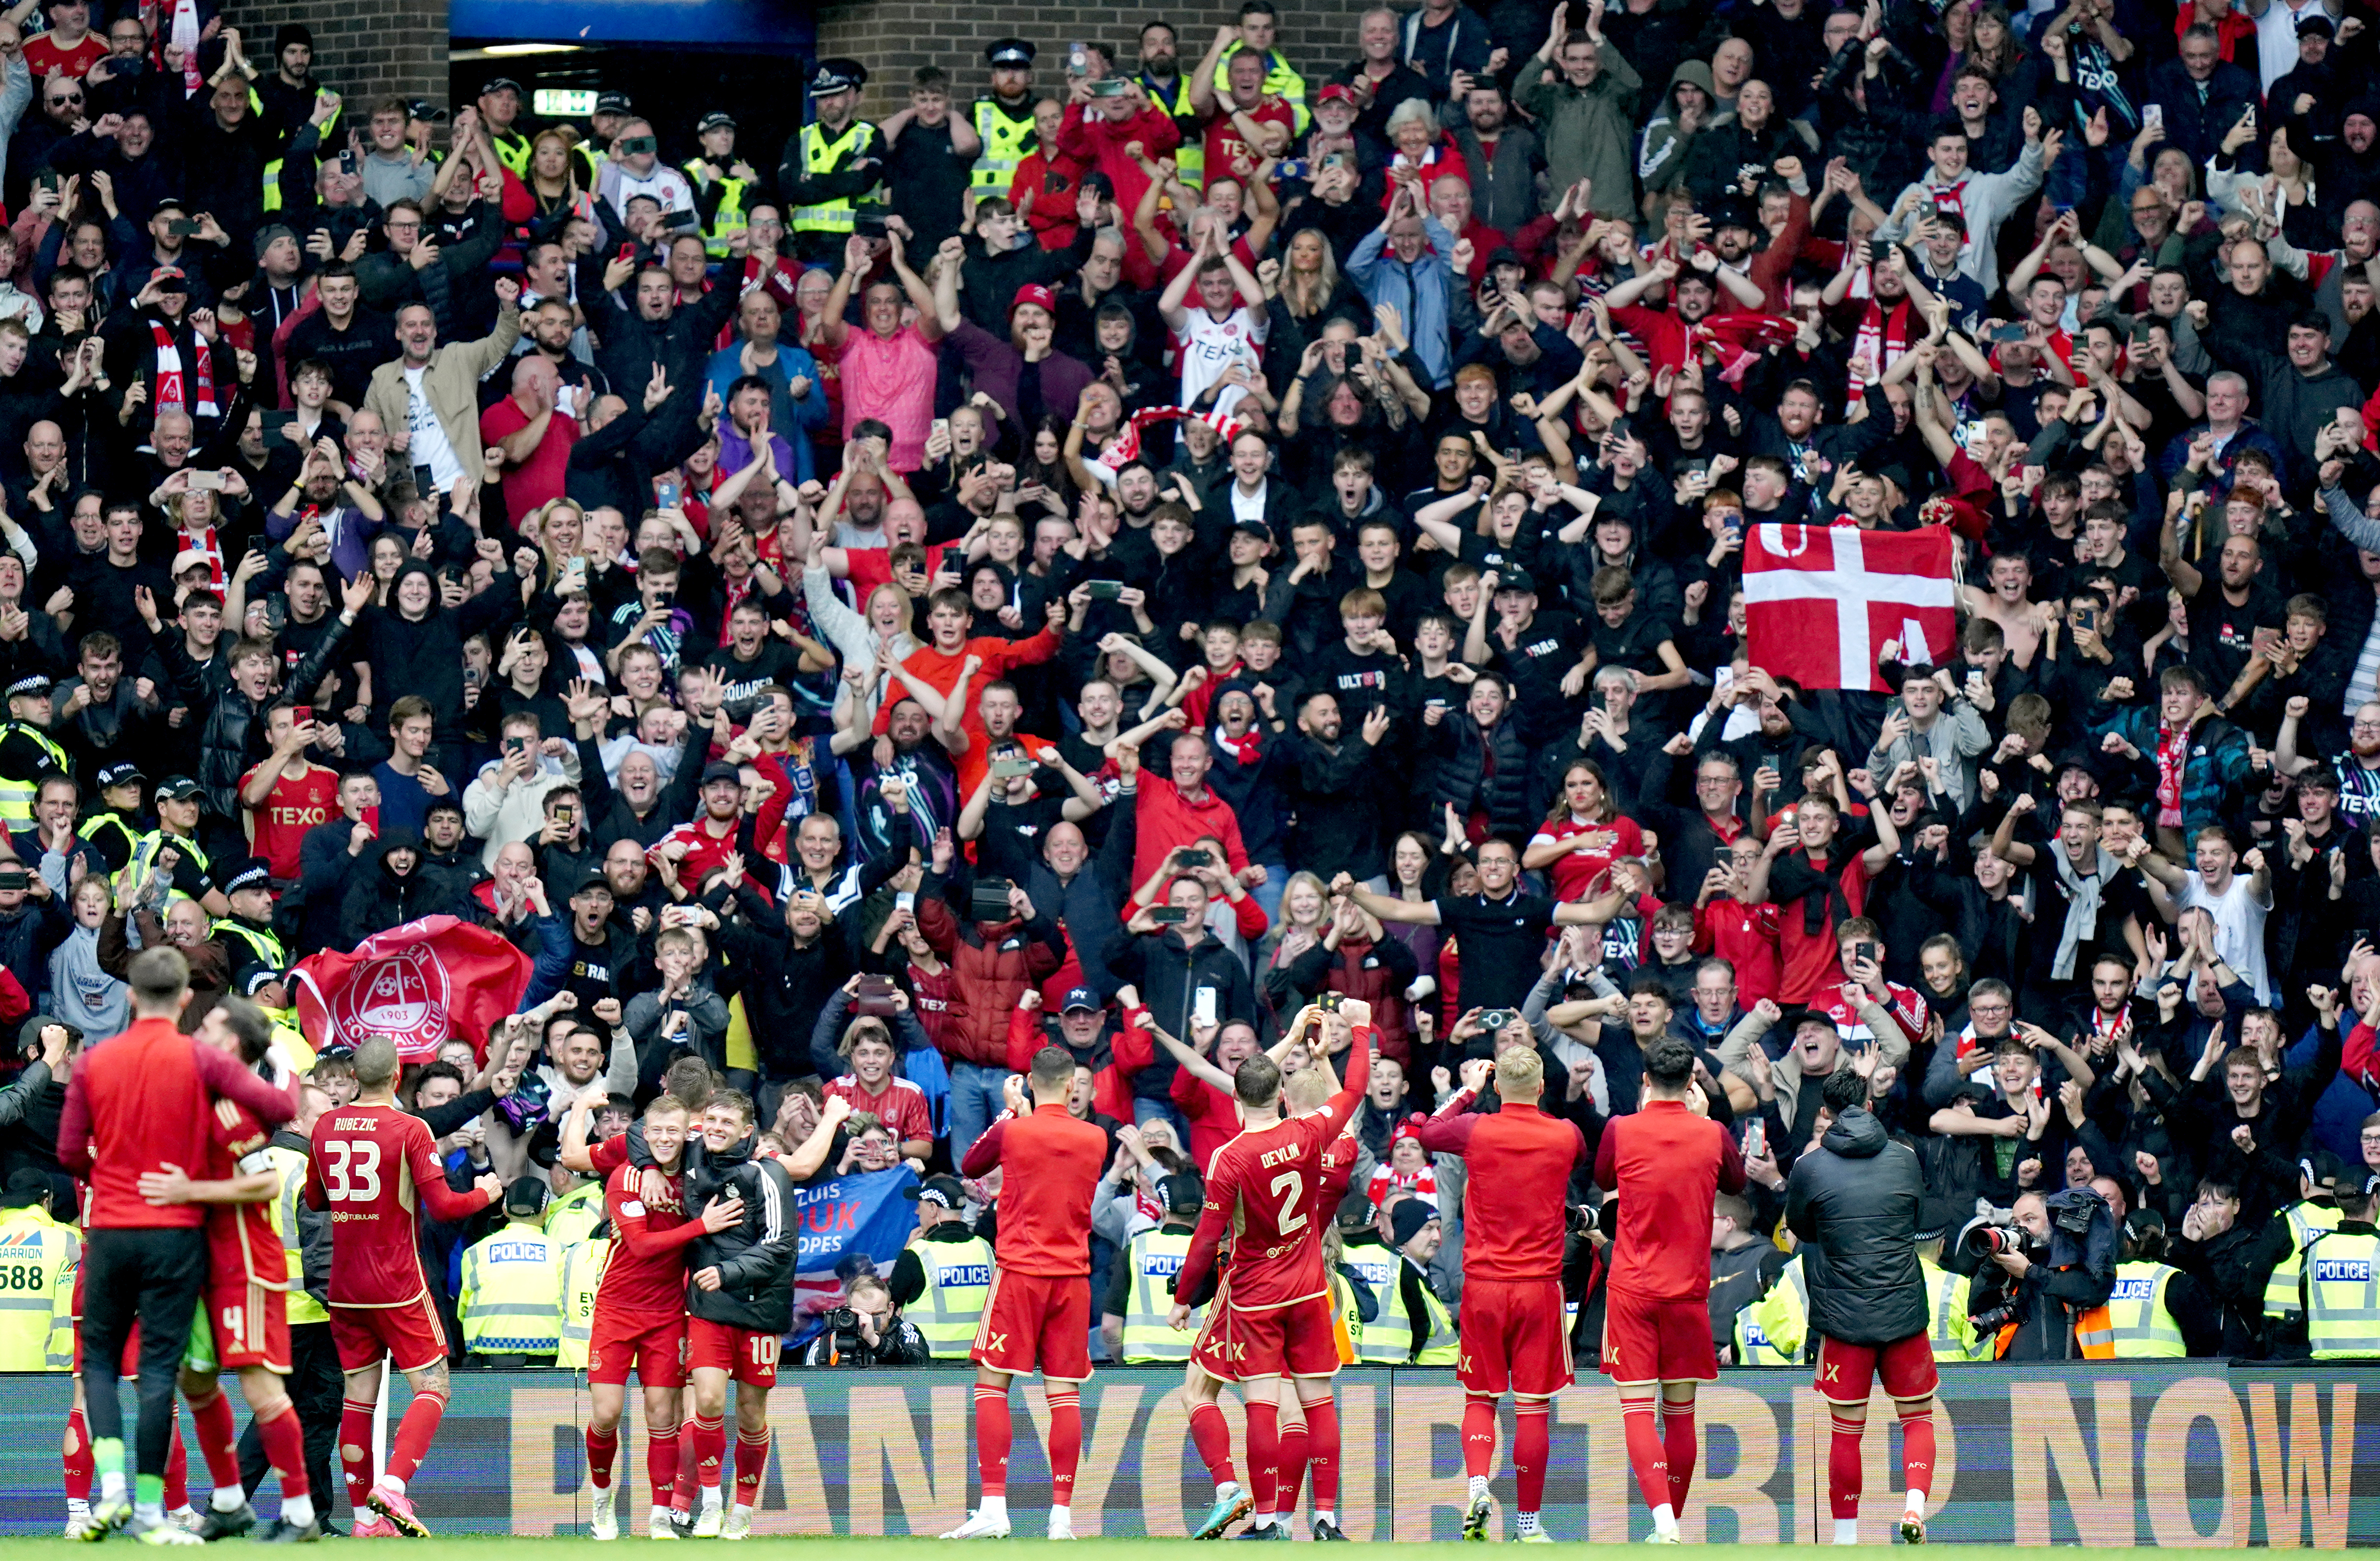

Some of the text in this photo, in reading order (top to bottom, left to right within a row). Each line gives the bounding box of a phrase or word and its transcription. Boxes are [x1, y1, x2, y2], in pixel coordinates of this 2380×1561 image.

[270, 806, 326, 825] TEXO
[404, 976, 421, 989] FC
[1070, 989, 1088, 999] NY
[383, 1010, 410, 1020] 1903
[334, 1117, 378, 1132] RUBEZIC
[1260, 1142, 1300, 1169] DEVLIN
[325, 1140, 381, 1201] 33
[798, 1183, 841, 1207] LUIS
[1270, 1171, 1308, 1236] 2
[0, 1248, 42, 1259] ARRION
[491, 1242, 546, 1262] POLICE
[940, 1267, 990, 1285] POLICE
[2317, 1261, 2369, 1280] POLICE
[223, 1305, 245, 1341] 4
[749, 1336, 776, 1364] 10
[1469, 1434, 1492, 1442] AFC
[2010, 1377, 2358, 1549] NOW
